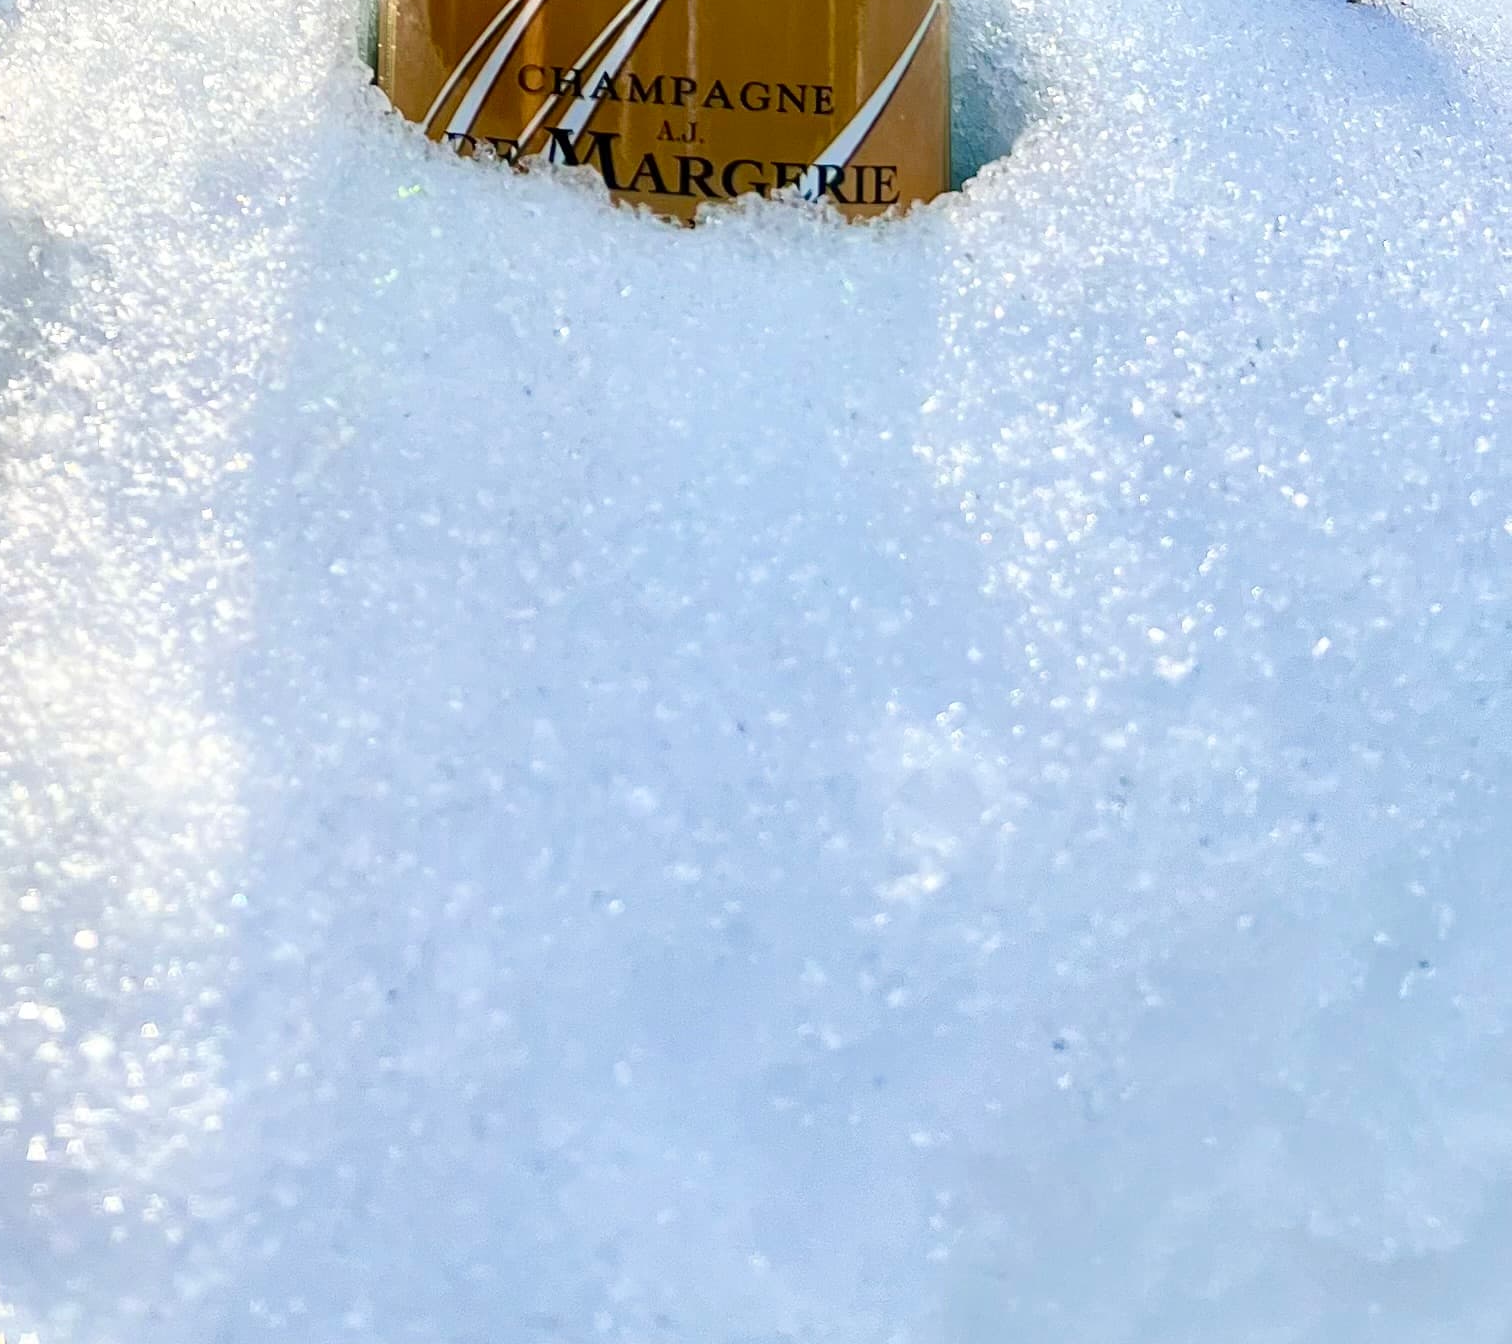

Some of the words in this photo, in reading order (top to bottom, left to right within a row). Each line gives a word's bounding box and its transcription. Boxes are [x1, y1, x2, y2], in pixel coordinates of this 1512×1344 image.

[517, 64, 835, 115] CHAMPAGNE
[656, 119, 705, 144] A.J.
[544, 127, 902, 204] MARGERIE
